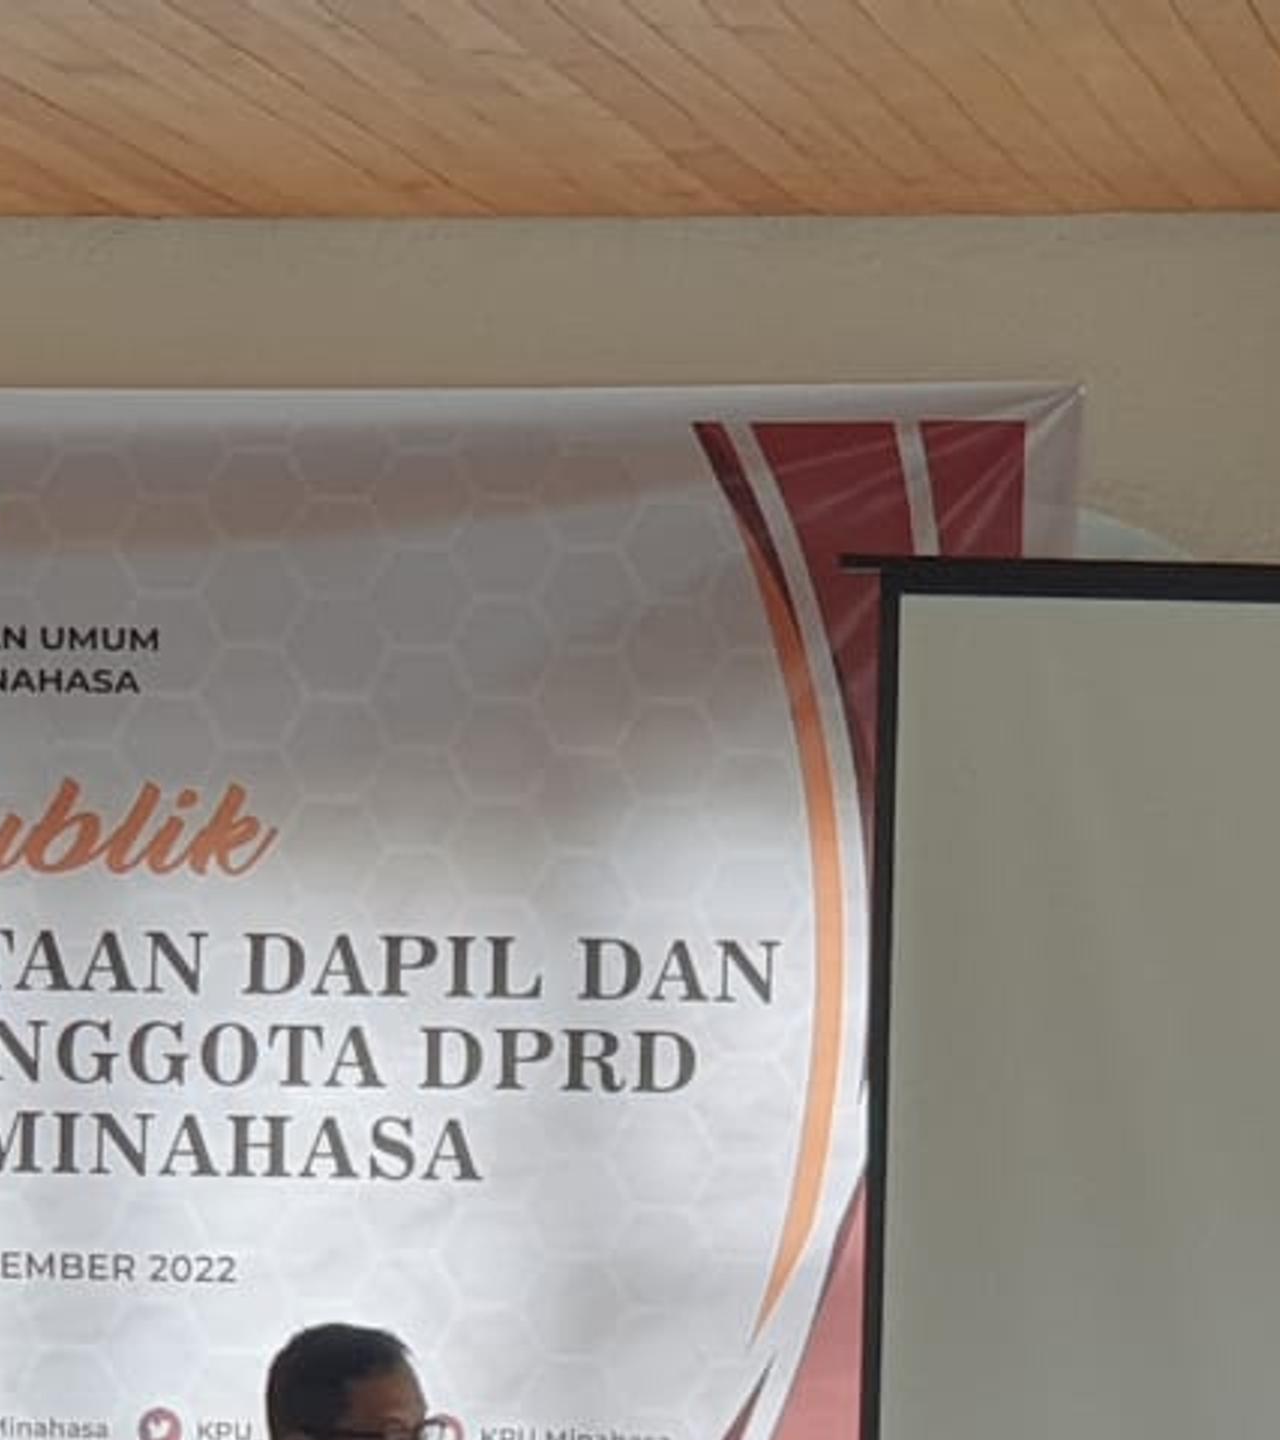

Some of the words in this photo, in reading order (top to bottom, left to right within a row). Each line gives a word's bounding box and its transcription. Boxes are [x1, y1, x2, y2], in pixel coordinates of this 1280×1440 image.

[41, 626, 160, 653] UMUM
[242, 932, 543, 1000] DAPIL
[578, 937, 783, 1004] DAN
[420, 1027, 697, 1094] DPRD
[148, 1254, 237, 1284] 2022
